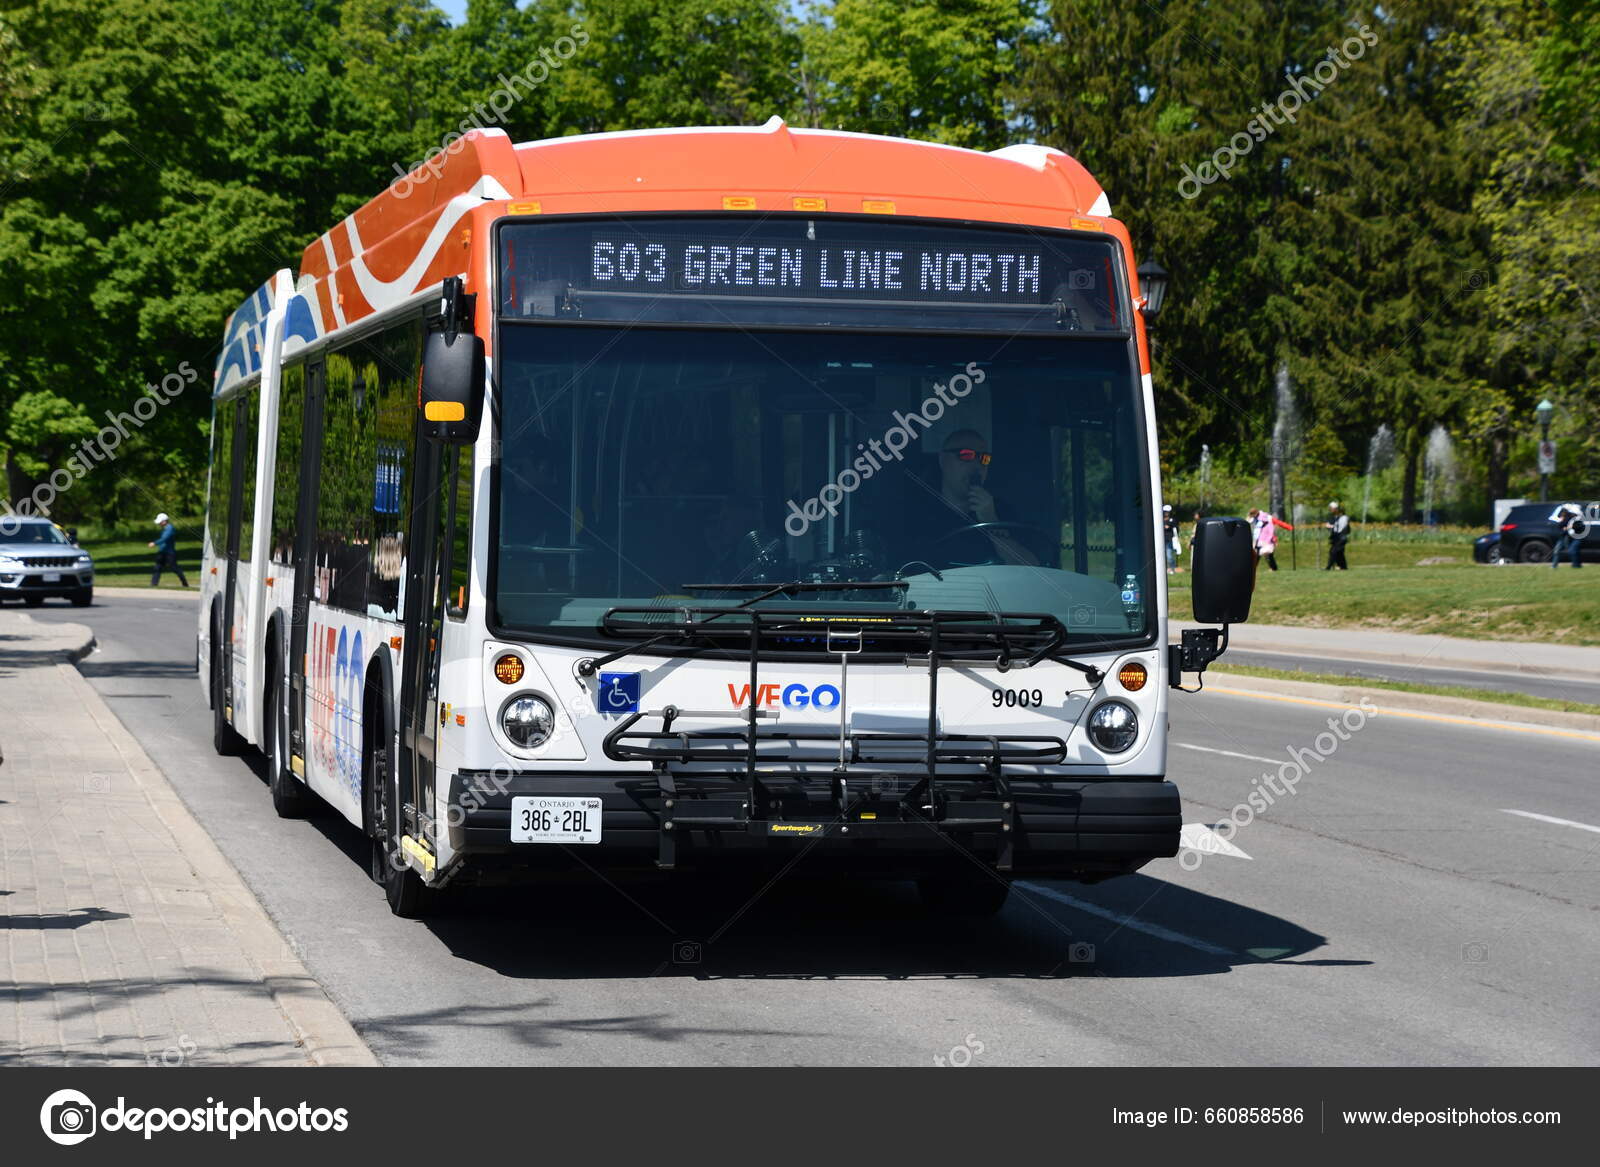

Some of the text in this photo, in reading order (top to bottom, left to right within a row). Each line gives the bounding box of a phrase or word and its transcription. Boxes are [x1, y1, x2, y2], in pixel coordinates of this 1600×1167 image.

[593, 241, 1040, 293] 603 GREEN LINE NORTH
[727, 683, 841, 713] WEGO
[992, 688, 1043, 708] 9009
[521, 809, 592, 832] 386 2BL
[771, 824, 814, 832] Sportworks
